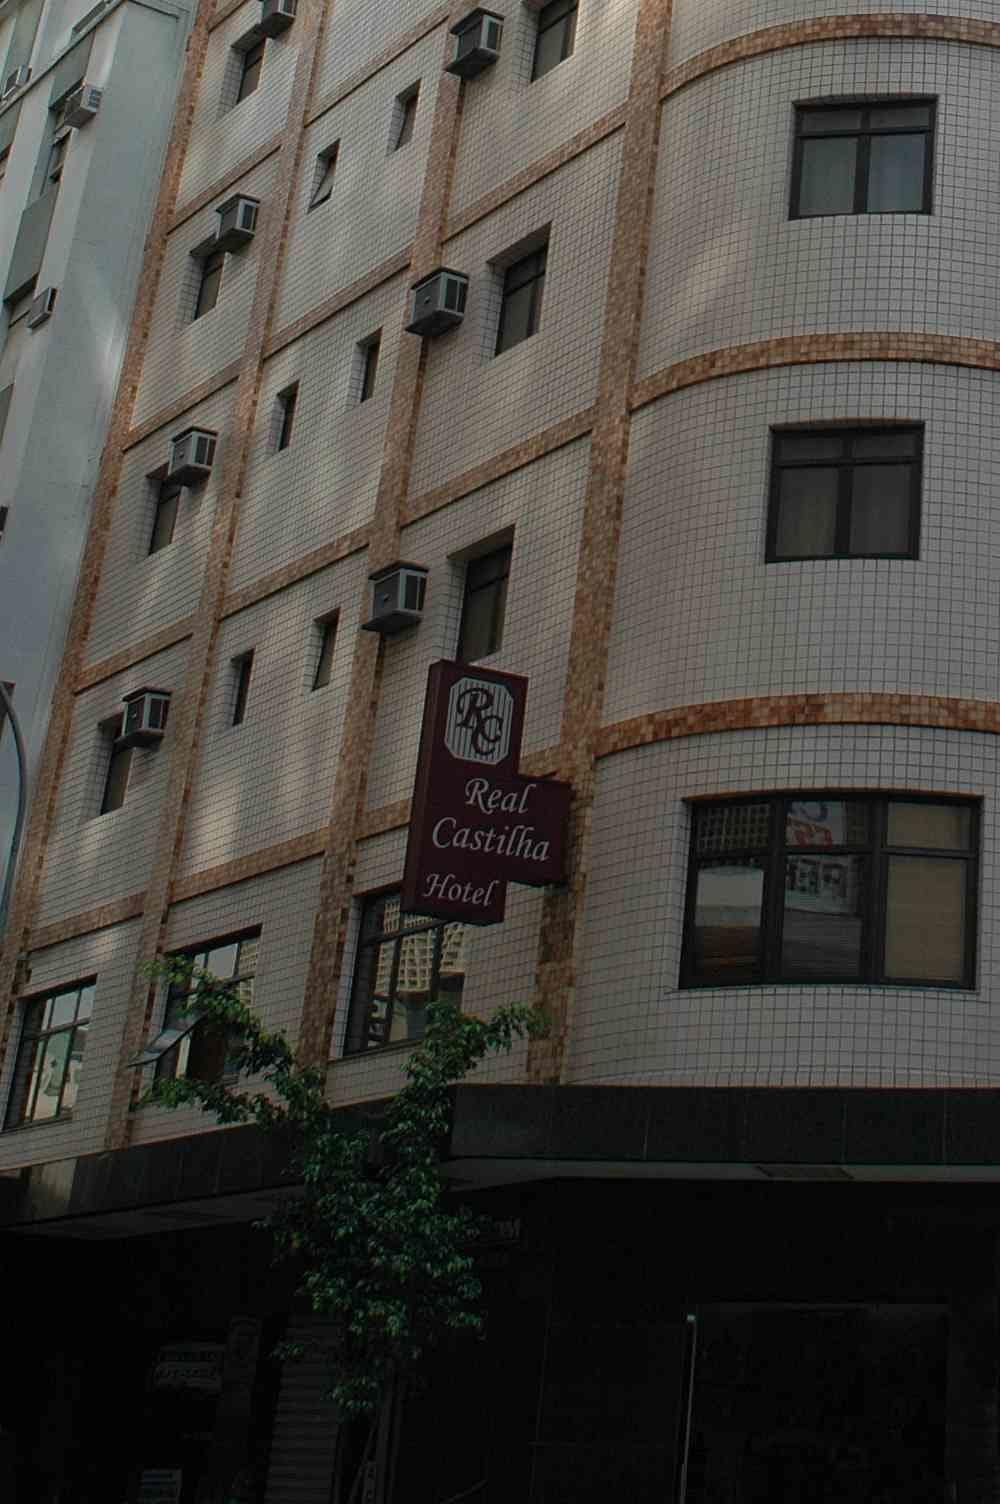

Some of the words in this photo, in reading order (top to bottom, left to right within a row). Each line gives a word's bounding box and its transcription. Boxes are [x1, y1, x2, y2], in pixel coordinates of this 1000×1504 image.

[464, 777, 536, 815] Real
[432, 816, 551, 862] Castilha
[423, 873, 499, 907] Hotel
